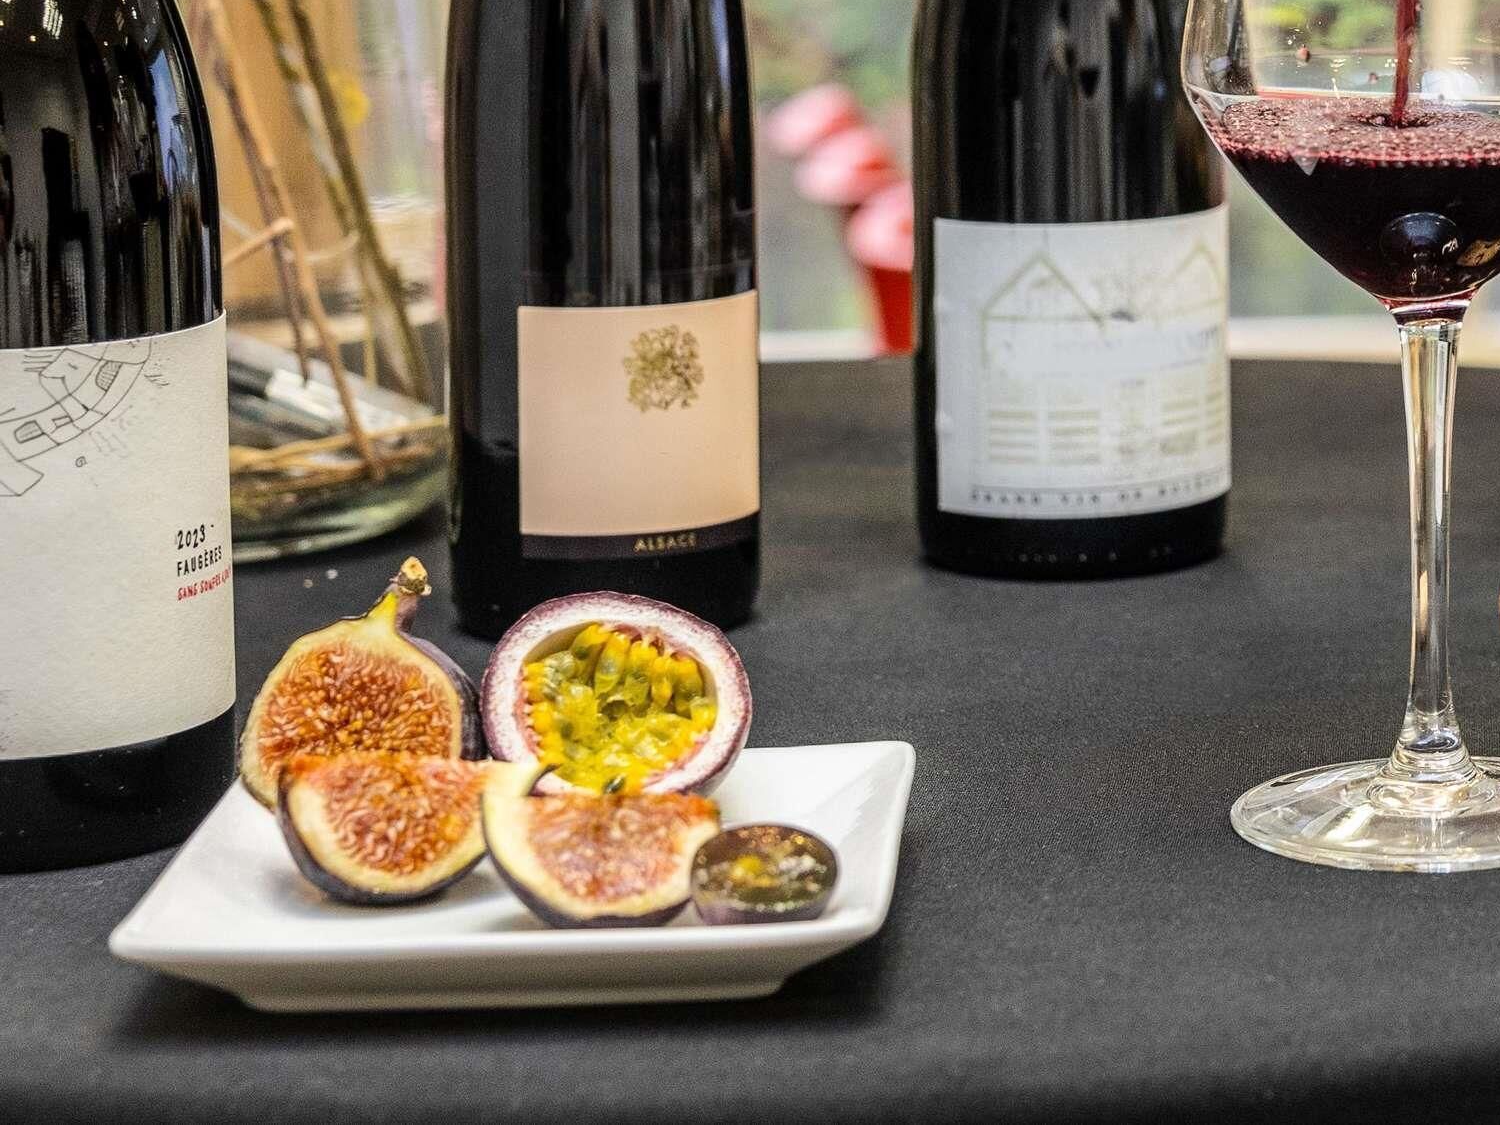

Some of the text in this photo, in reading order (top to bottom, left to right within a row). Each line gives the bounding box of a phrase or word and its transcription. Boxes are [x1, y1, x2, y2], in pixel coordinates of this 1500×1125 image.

[177, 524, 206, 550] 2023
[635, 533, 698, 552] ALSACE
[177, 545, 222, 577] FAUGÈRES
[177, 582, 198, 601] SANS
